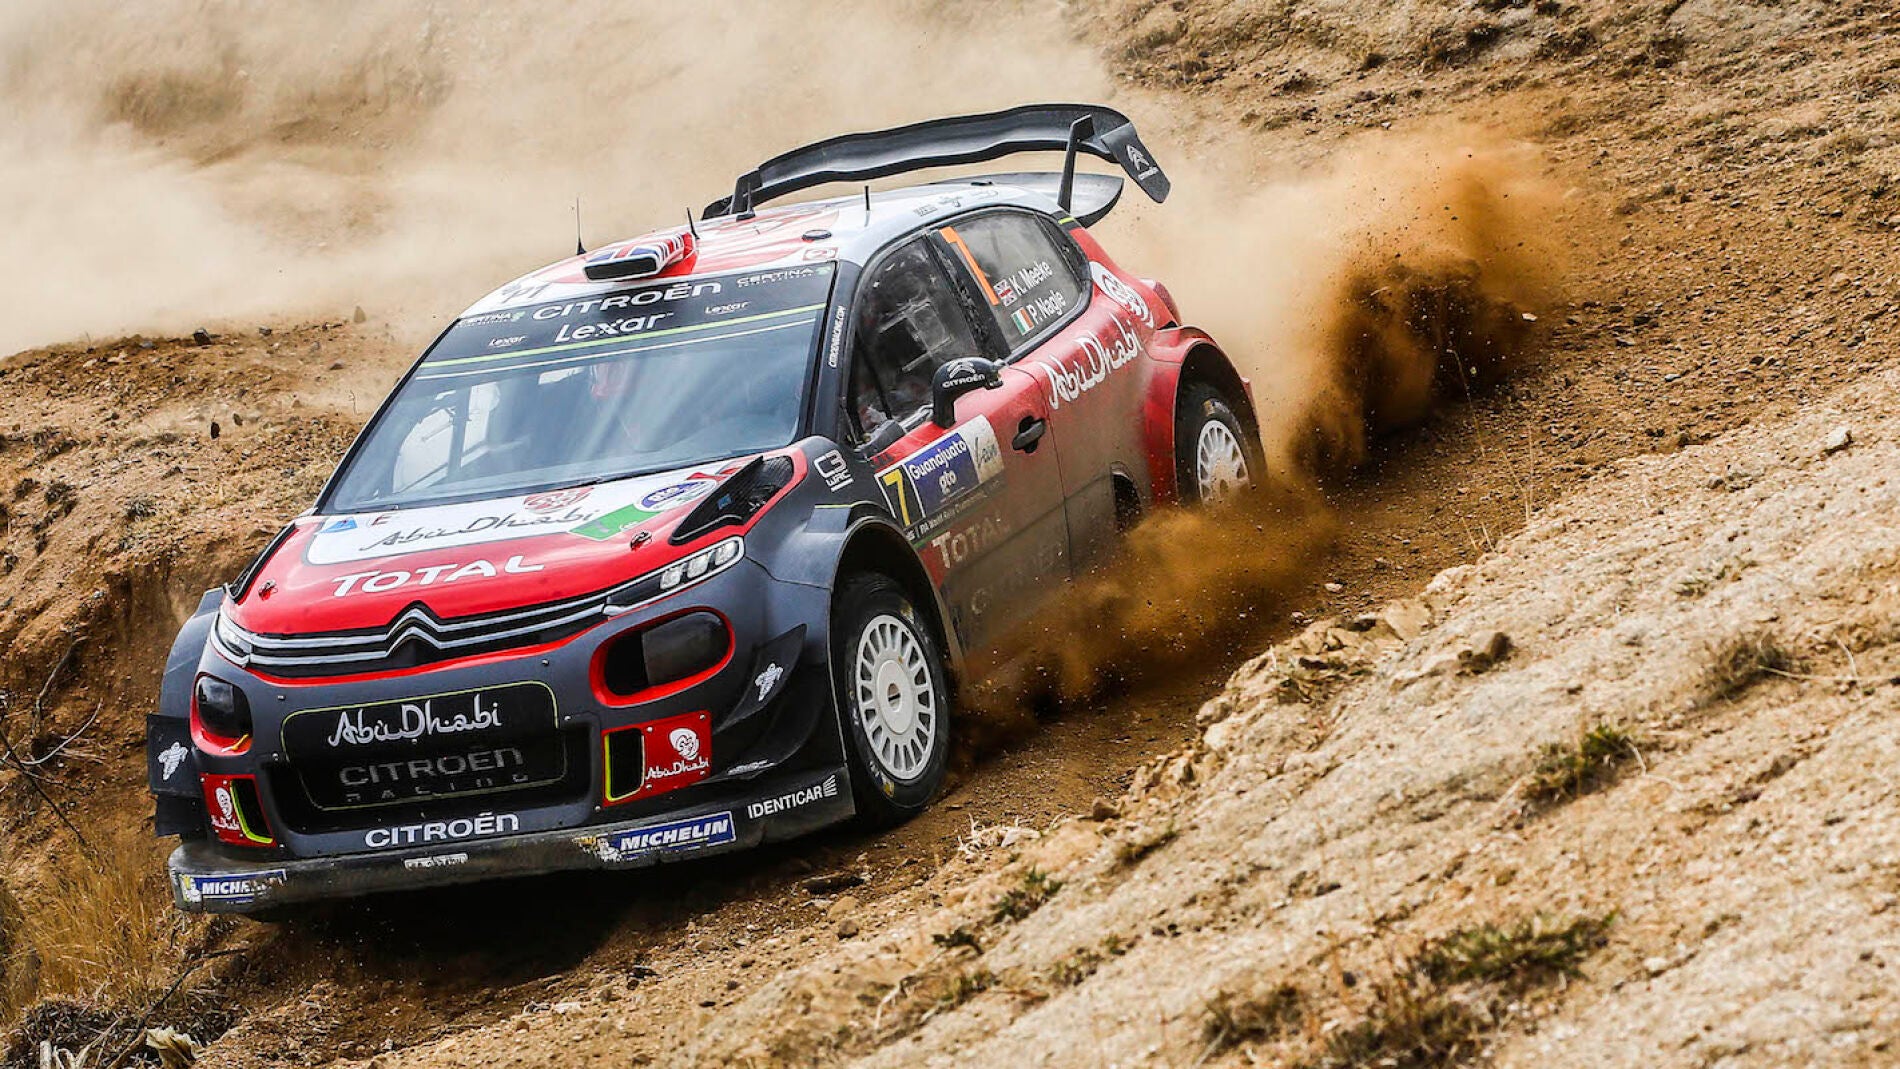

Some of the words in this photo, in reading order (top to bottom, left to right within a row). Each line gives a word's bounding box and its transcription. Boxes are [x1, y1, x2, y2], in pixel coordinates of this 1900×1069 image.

[1009, 274, 1028, 296] K.
[1018, 260, 1053, 290] Meeke
[533, 281, 722, 320] CITROËN
[1026, 304, 1043, 325] P.
[1035, 289, 1066, 319] Nagle
[555, 313, 668, 343] Lexar
[908, 440, 967, 480] Guanajuato
[882, 468, 912, 527] 7
[331, 555, 545, 597] TOTAL
[747, 785, 824, 819] IDENTICAR
[365, 811, 520, 848] CITROËN
[620, 818, 729, 850] MICHELIN
